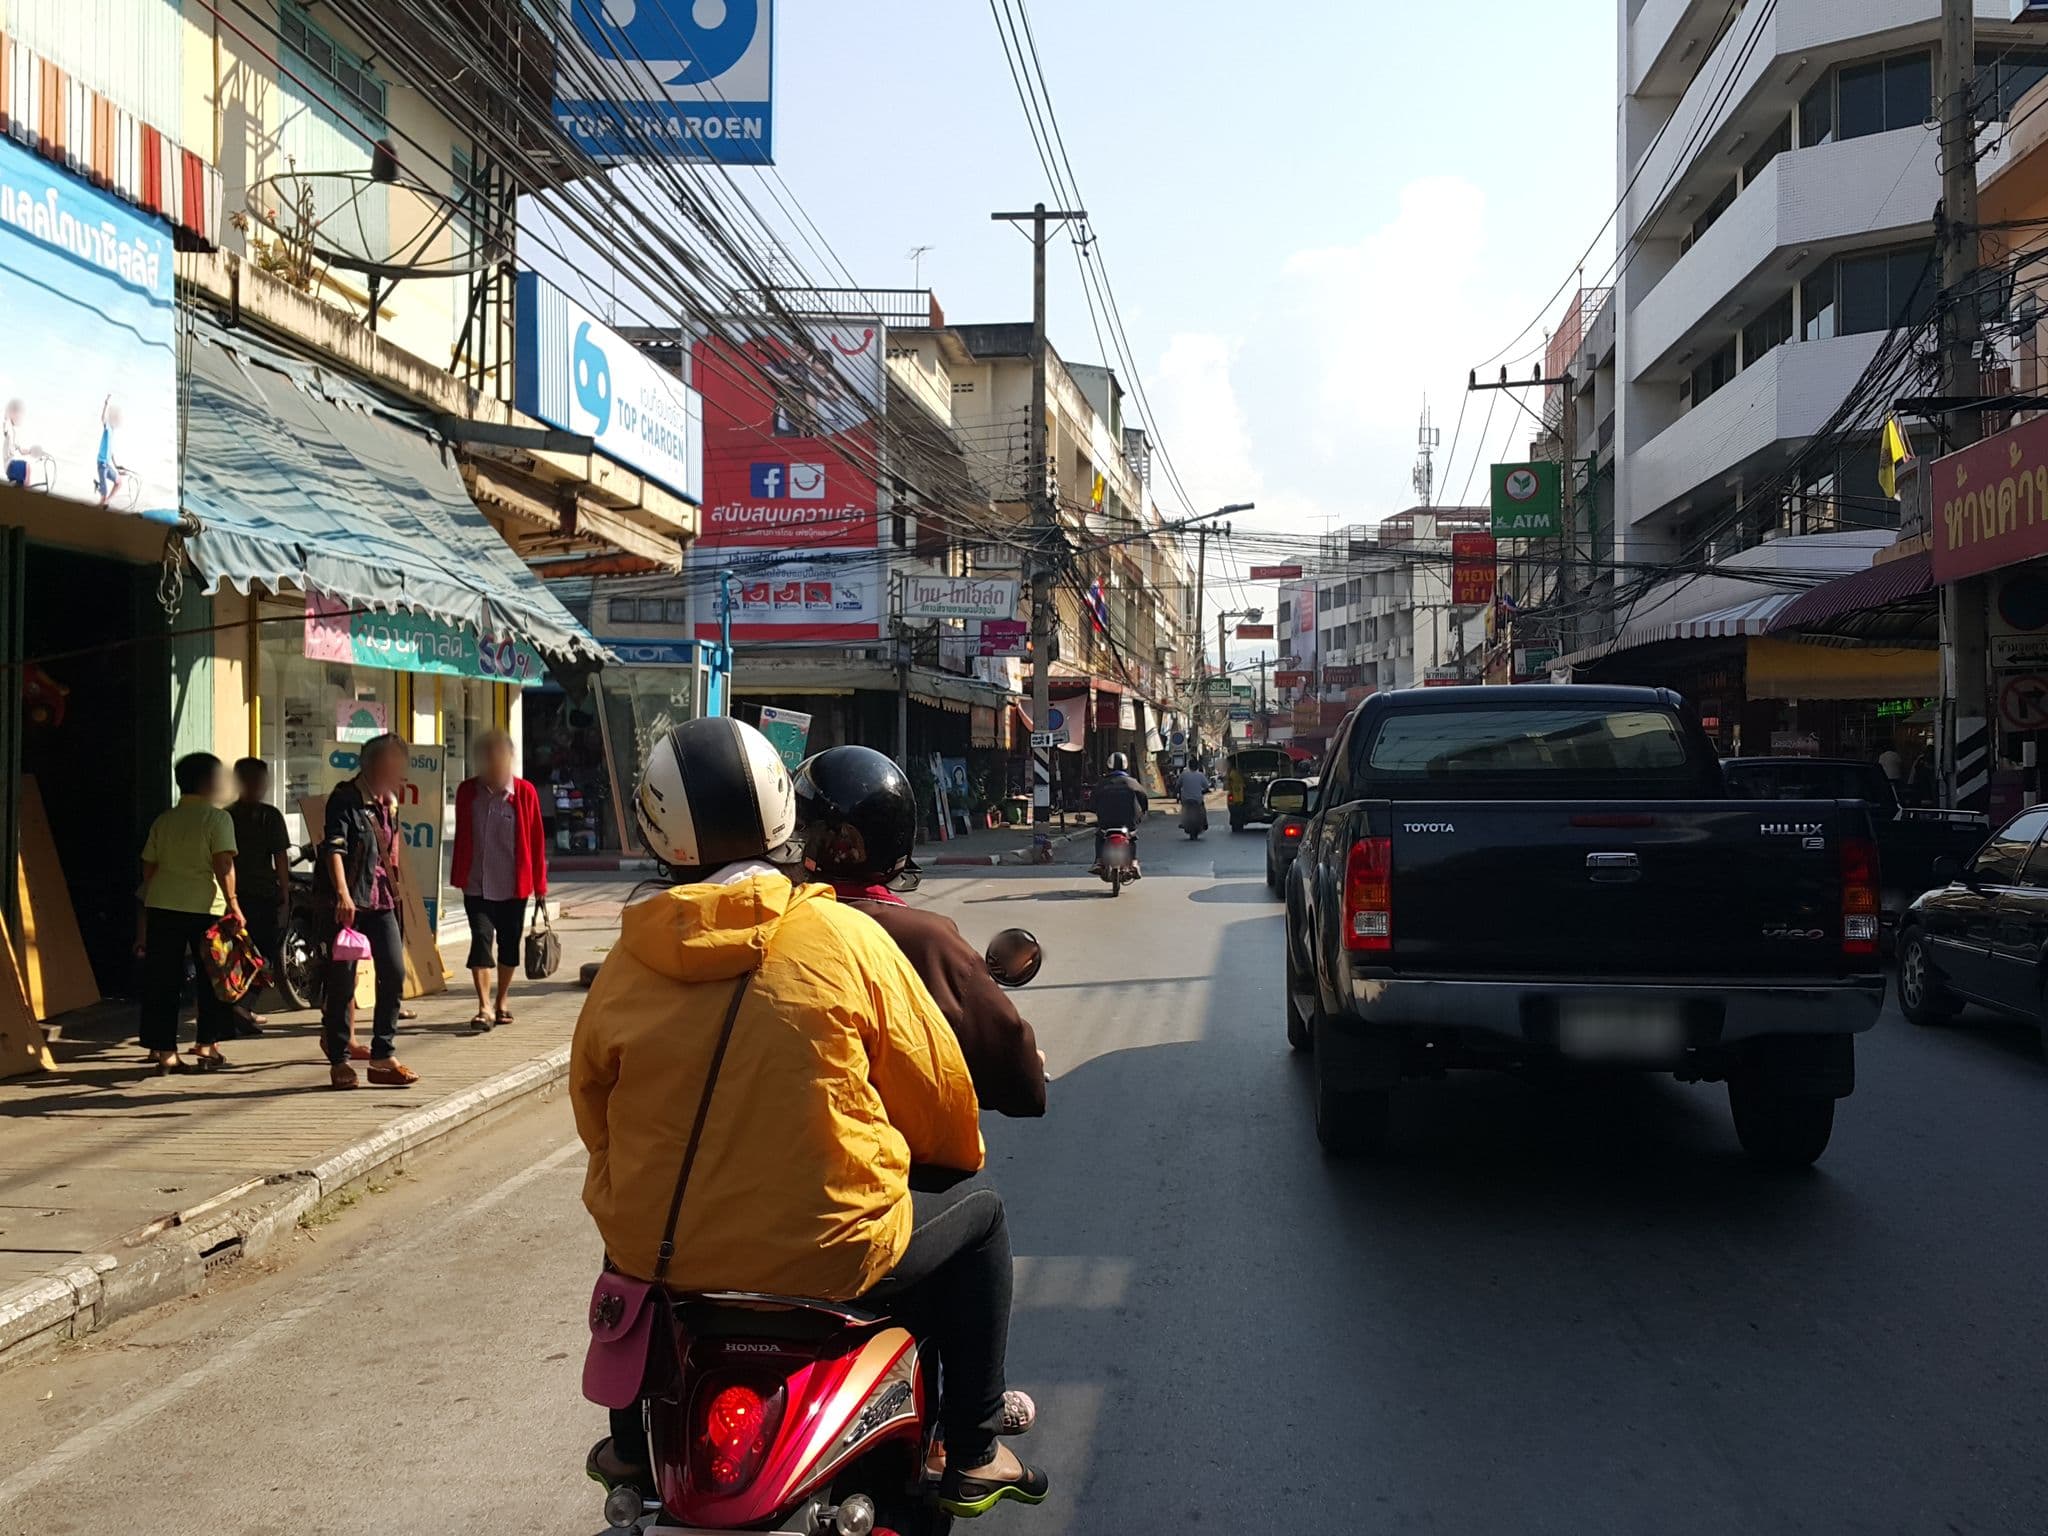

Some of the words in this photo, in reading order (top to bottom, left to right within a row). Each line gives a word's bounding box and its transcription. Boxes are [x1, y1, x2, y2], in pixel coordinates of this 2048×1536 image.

[557, 115, 614, 139] TOP
[624, 117, 762, 139] CHAROEN
[617, 398, 637, 433] TOP
[641, 413, 684, 464] CHAROEN
[711, 503, 866, 526] สนับสนุนความรัก
[1512, 514, 1550, 528] ATM
[1403, 823, 1455, 832] TOYOTA
[1760, 823, 1825, 835] HILUX
[725, 1343, 781, 1352] HONDA
